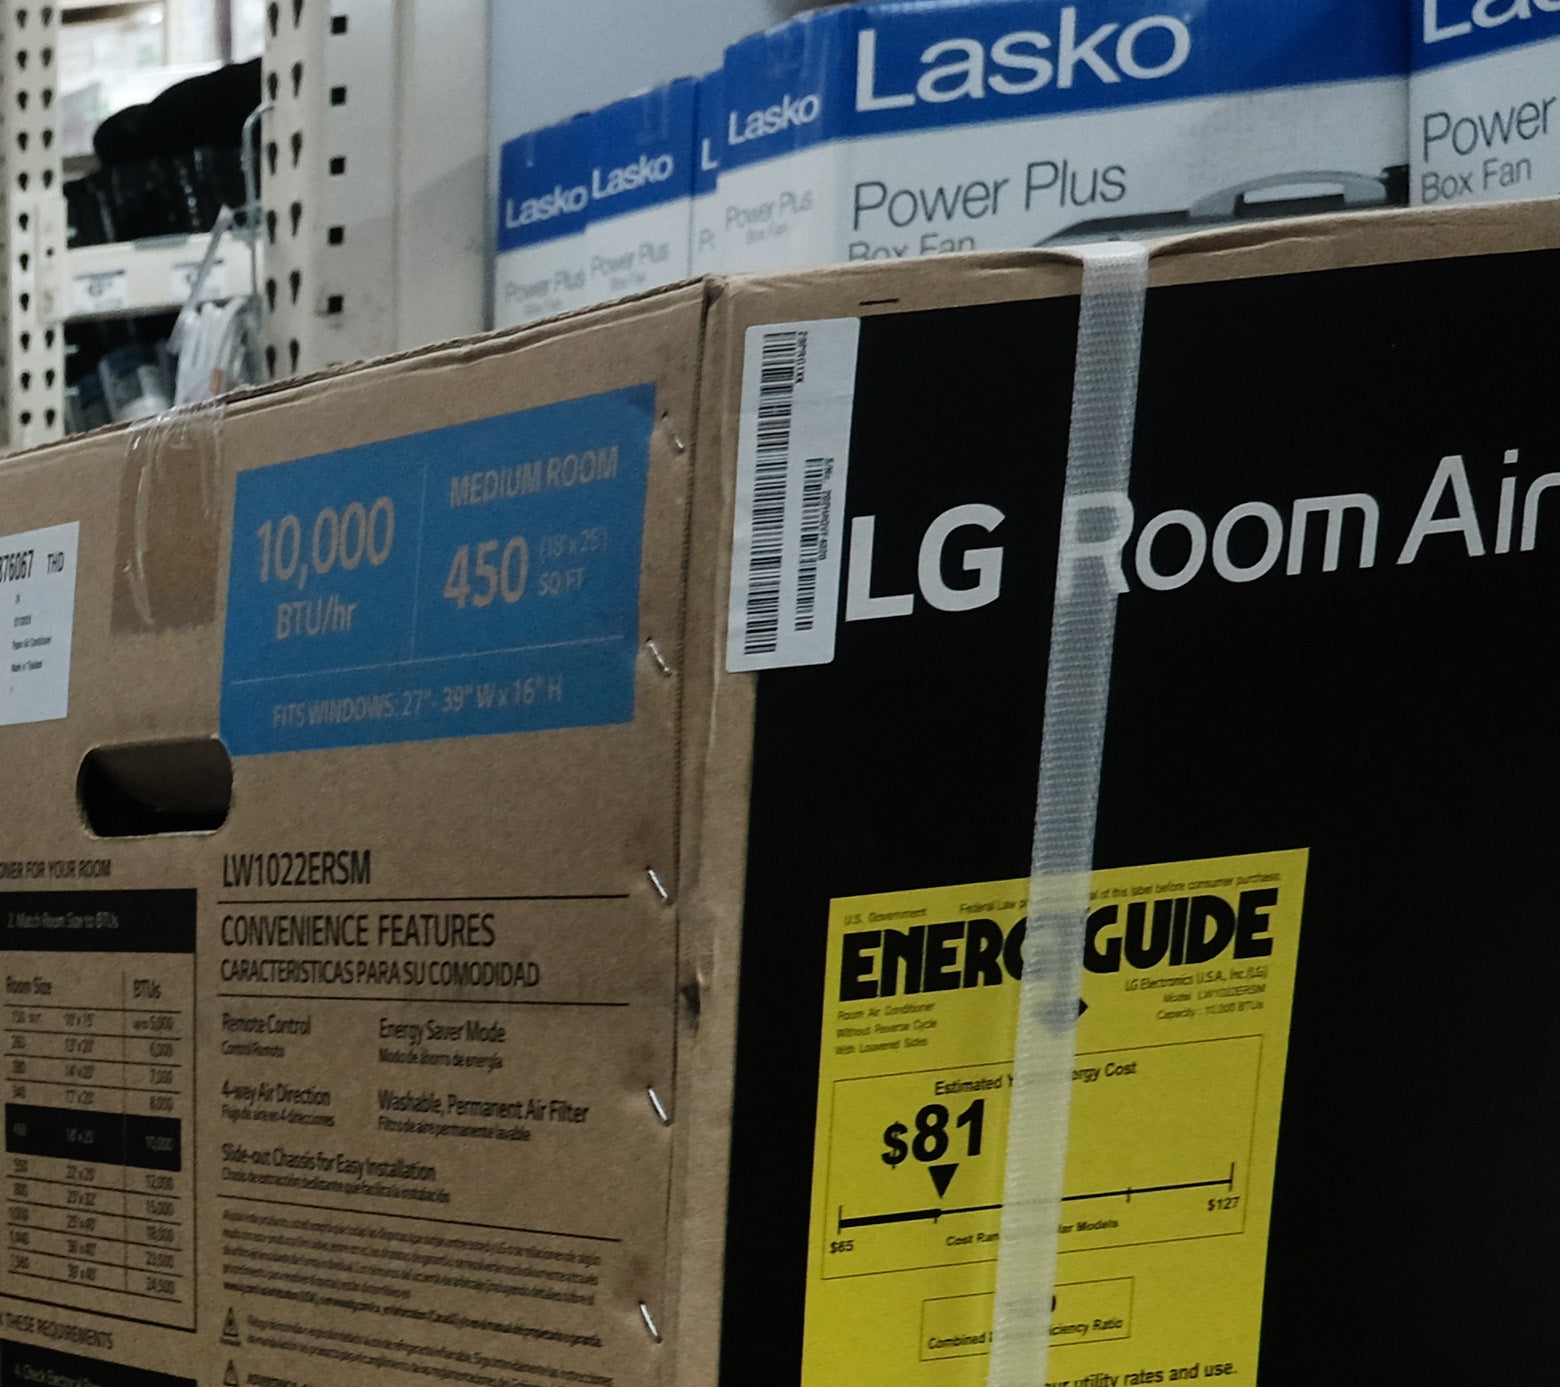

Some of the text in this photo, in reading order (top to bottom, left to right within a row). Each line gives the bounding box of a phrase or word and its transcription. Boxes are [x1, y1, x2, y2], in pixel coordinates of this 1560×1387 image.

[855, 10, 1190, 113] Lasko
[726, 87, 821, 148] Lasko
[1422, 92, 1557, 166] Power
[505, 181, 589, 230] Lasko
[589, 154, 676, 199] Lasko
[851, 156, 1128, 231] Power Plus
[1420, 153, 1534, 204] Box Fan
[450, 447, 618, 508] MEDIUM ROOM
[255, 496, 396, 585] 10,000
[845, 502, 1006, 623] LG
[1059, 490, 1380, 600] Room
[441, 535, 530, 611] 450
[275, 597, 355, 641] BTU/hr
[222, 850, 372, 888] LW1022ERSM
[221, 913, 495, 949] CONVENIENCE FEATURES
[352, 960, 400, 985] PARA
[402, 961, 426, 985] SU
[427, 960, 539, 988] COMODIDAD
[880, 1098, 988, 1169] $81
